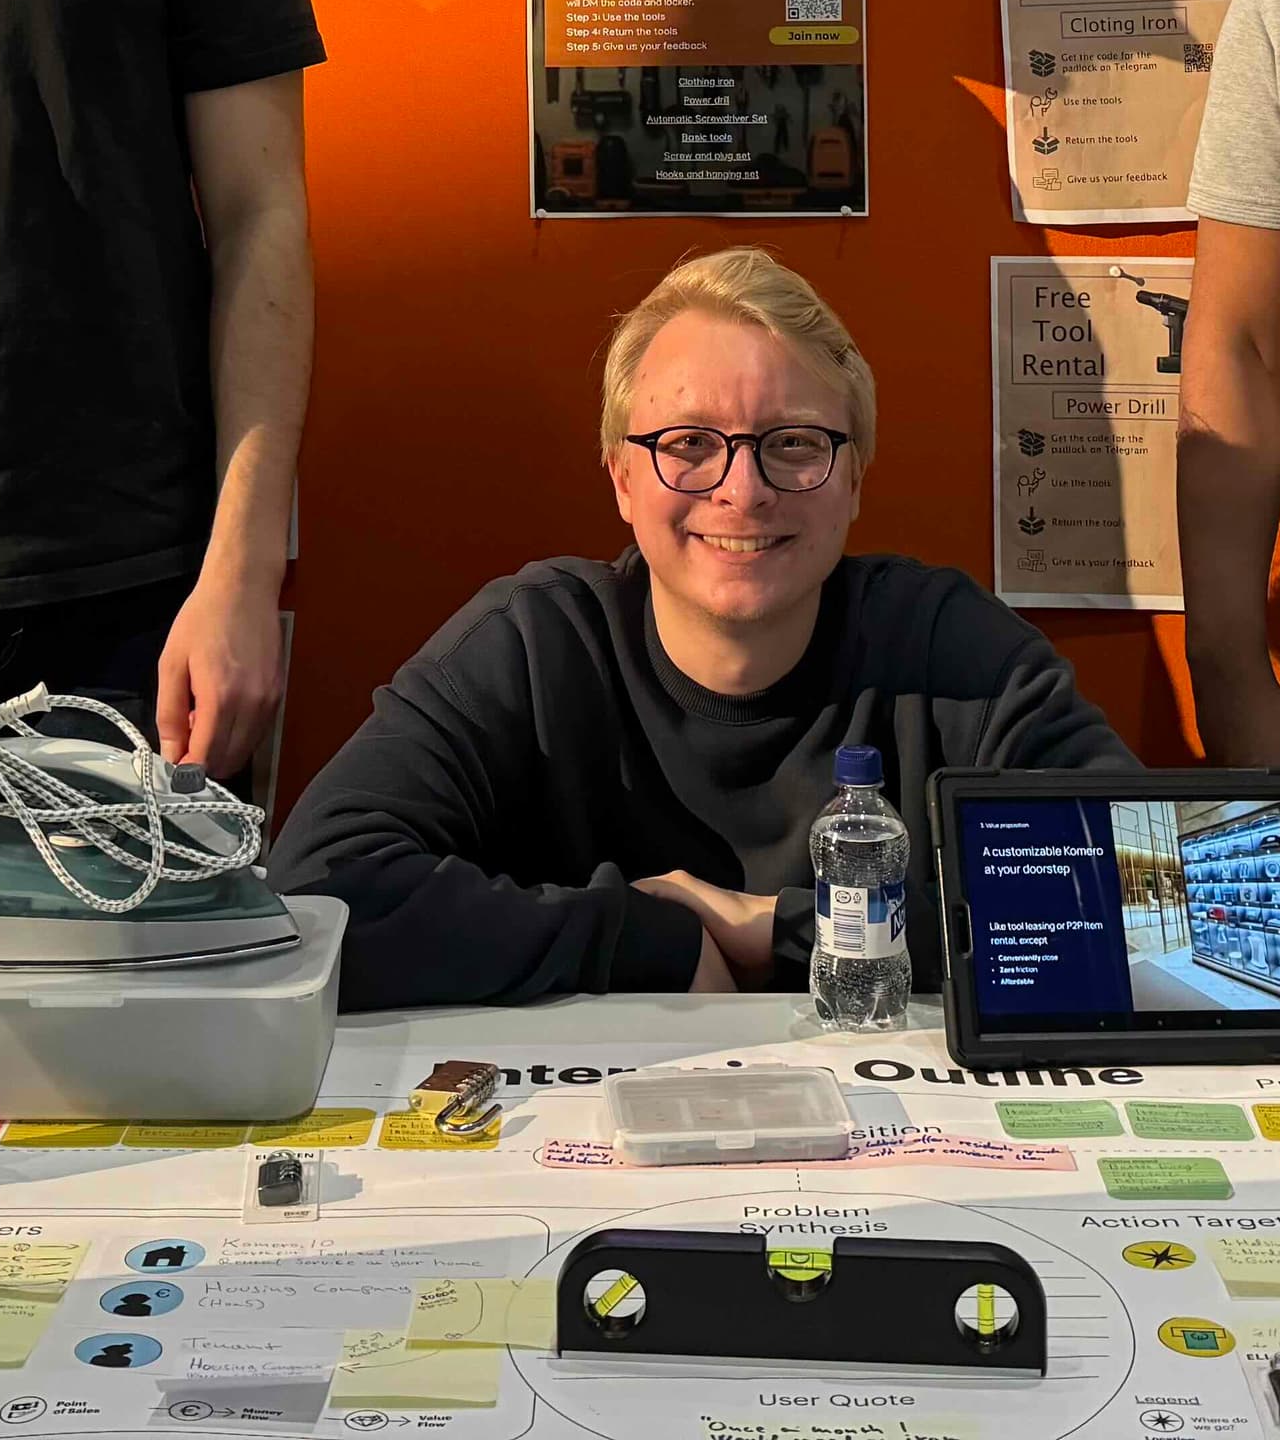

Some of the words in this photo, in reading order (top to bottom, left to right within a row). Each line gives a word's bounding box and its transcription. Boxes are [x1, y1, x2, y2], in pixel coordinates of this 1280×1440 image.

[566, 13, 589, 24] Step
[602, 13, 622, 22] Use
[624, 13, 640, 22] the
[641, 13, 666, 22] tools
[1070, 17, 1135, 35] Cloting
[1142, 16, 1178, 31] Iron
[566, 27, 589, 38] Step
[602, 27, 634, 38] Return
[636, 27, 651, 37] the
[653, 27, 678, 37] tools
[788, 31, 812, 41] Join
[814, 32, 840, 41] now
[566, 42, 589, 53] Step
[602, 42, 624, 52] Give
[639, 43, 661, 54] your
[662, 41, 707, 52] feedback
[1079, 53, 1094, 62] the
[1096, 52, 1120, 61] code
[1120, 51, 1135, 62] for
[1062, 63, 1098, 74] padlock
[1114, 62, 1157, 74] Telegram
[678, 77, 715, 88] Clothing
[683, 95, 713, 106] Power
[1064, 98, 1080, 107] Use
[1082, 98, 1097, 106] the
[1100, 97, 1122, 106] tools
[646, 114, 693, 125] Automatic
[695, 114, 749, 125] Screwdriver
[751, 114, 768, 125] Set
[681, 133, 708, 143] Basic
[709, 133, 733, 143] tools
[1065, 136, 1096, 146] Return
[1098, 136, 1113, 145] the
[1115, 135, 1138, 144] tools
[663, 151, 693, 161] Screw
[695, 151, 712, 161] and
[714, 151, 734, 163] plug
[686, 170, 703, 180] and
[706, 170, 742, 182] hanging
[1067, 175, 1087, 184] Give
[1103, 176, 1123, 185] your
[1126, 173, 1168, 183] feedback
[1035, 286, 1091, 308] Free
[1032, 319, 1092, 342] Tool
[1023, 353, 1105, 376] Rental
[1067, 398, 1121, 415] Power
[1128, 398, 1166, 415] Drill
[1070, 434, 1084, 443] the
[1087, 434, 1109, 443] code
[1128, 434, 1143, 443] the
[1105, 445, 1148, 456] Telegram
[1051, 479, 1067, 488] Use
[1071, 479, 1086, 488] the
[1089, 559, 1109, 570] your
[1113, 558, 1155, 569] feedback
[992, 846, 1062, 857] customizable
[1064, 845, 1104, 857] Komero
[984, 865, 996, 875] at
[997, 866, 1021, 877] your
[1022, 864, 1070, 876] doorstep
[989, 922, 1006, 931] Like
[1007, 922, 1024, 931] tool
[1025, 921, 1055, 933] leasing
[1066, 921, 1083, 931] P2P
[1019, 936, 1048, 947] except
[853, 1058, 1145, 1088] Outline
[743, 1205, 870, 1218] Problem
[739, 1219, 889, 1235] Synthesis
[1081, 1215, 1180, 1230] Action
[55, 1399, 90, 1409] Point
[759, 1393, 821, 1406] User
[829, 1393, 916, 1407] Quote
[1135, 1396, 1202, 1406] Legend
[241, 1407, 284, 1418] Money
